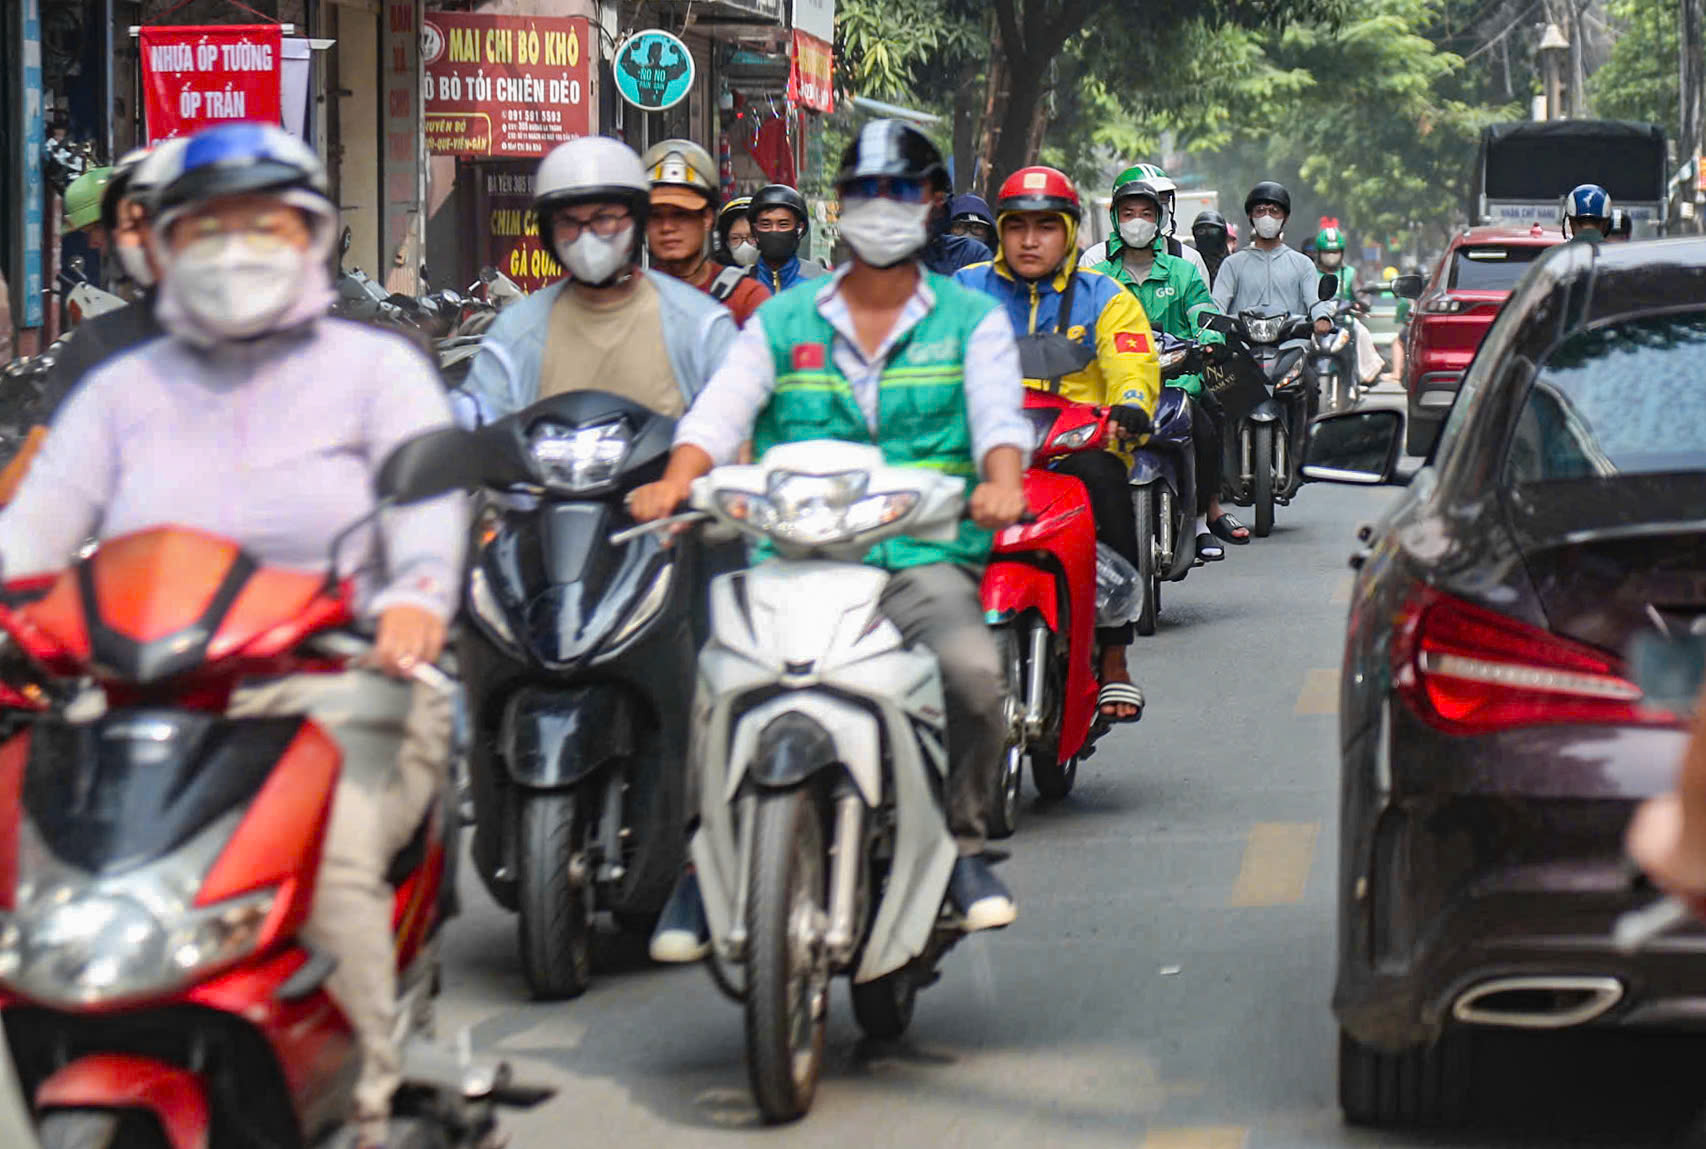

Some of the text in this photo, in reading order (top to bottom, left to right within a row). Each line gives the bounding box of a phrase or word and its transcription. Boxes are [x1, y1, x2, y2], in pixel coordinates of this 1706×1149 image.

[151, 35, 273, 79] NHỰA ỐP TƯỜNG
[449, 21, 579, 67] MAI CHI BÒ KHÔ
[181, 81, 245, 118] ỐP TRẦN
[439, 70, 461, 101] BÒ
[466, 68, 492, 101] TỎI
[496, 73, 545, 103] CHIÊN
[550, 72, 580, 104] DẺO
[510, 242, 528, 277] GÀ
